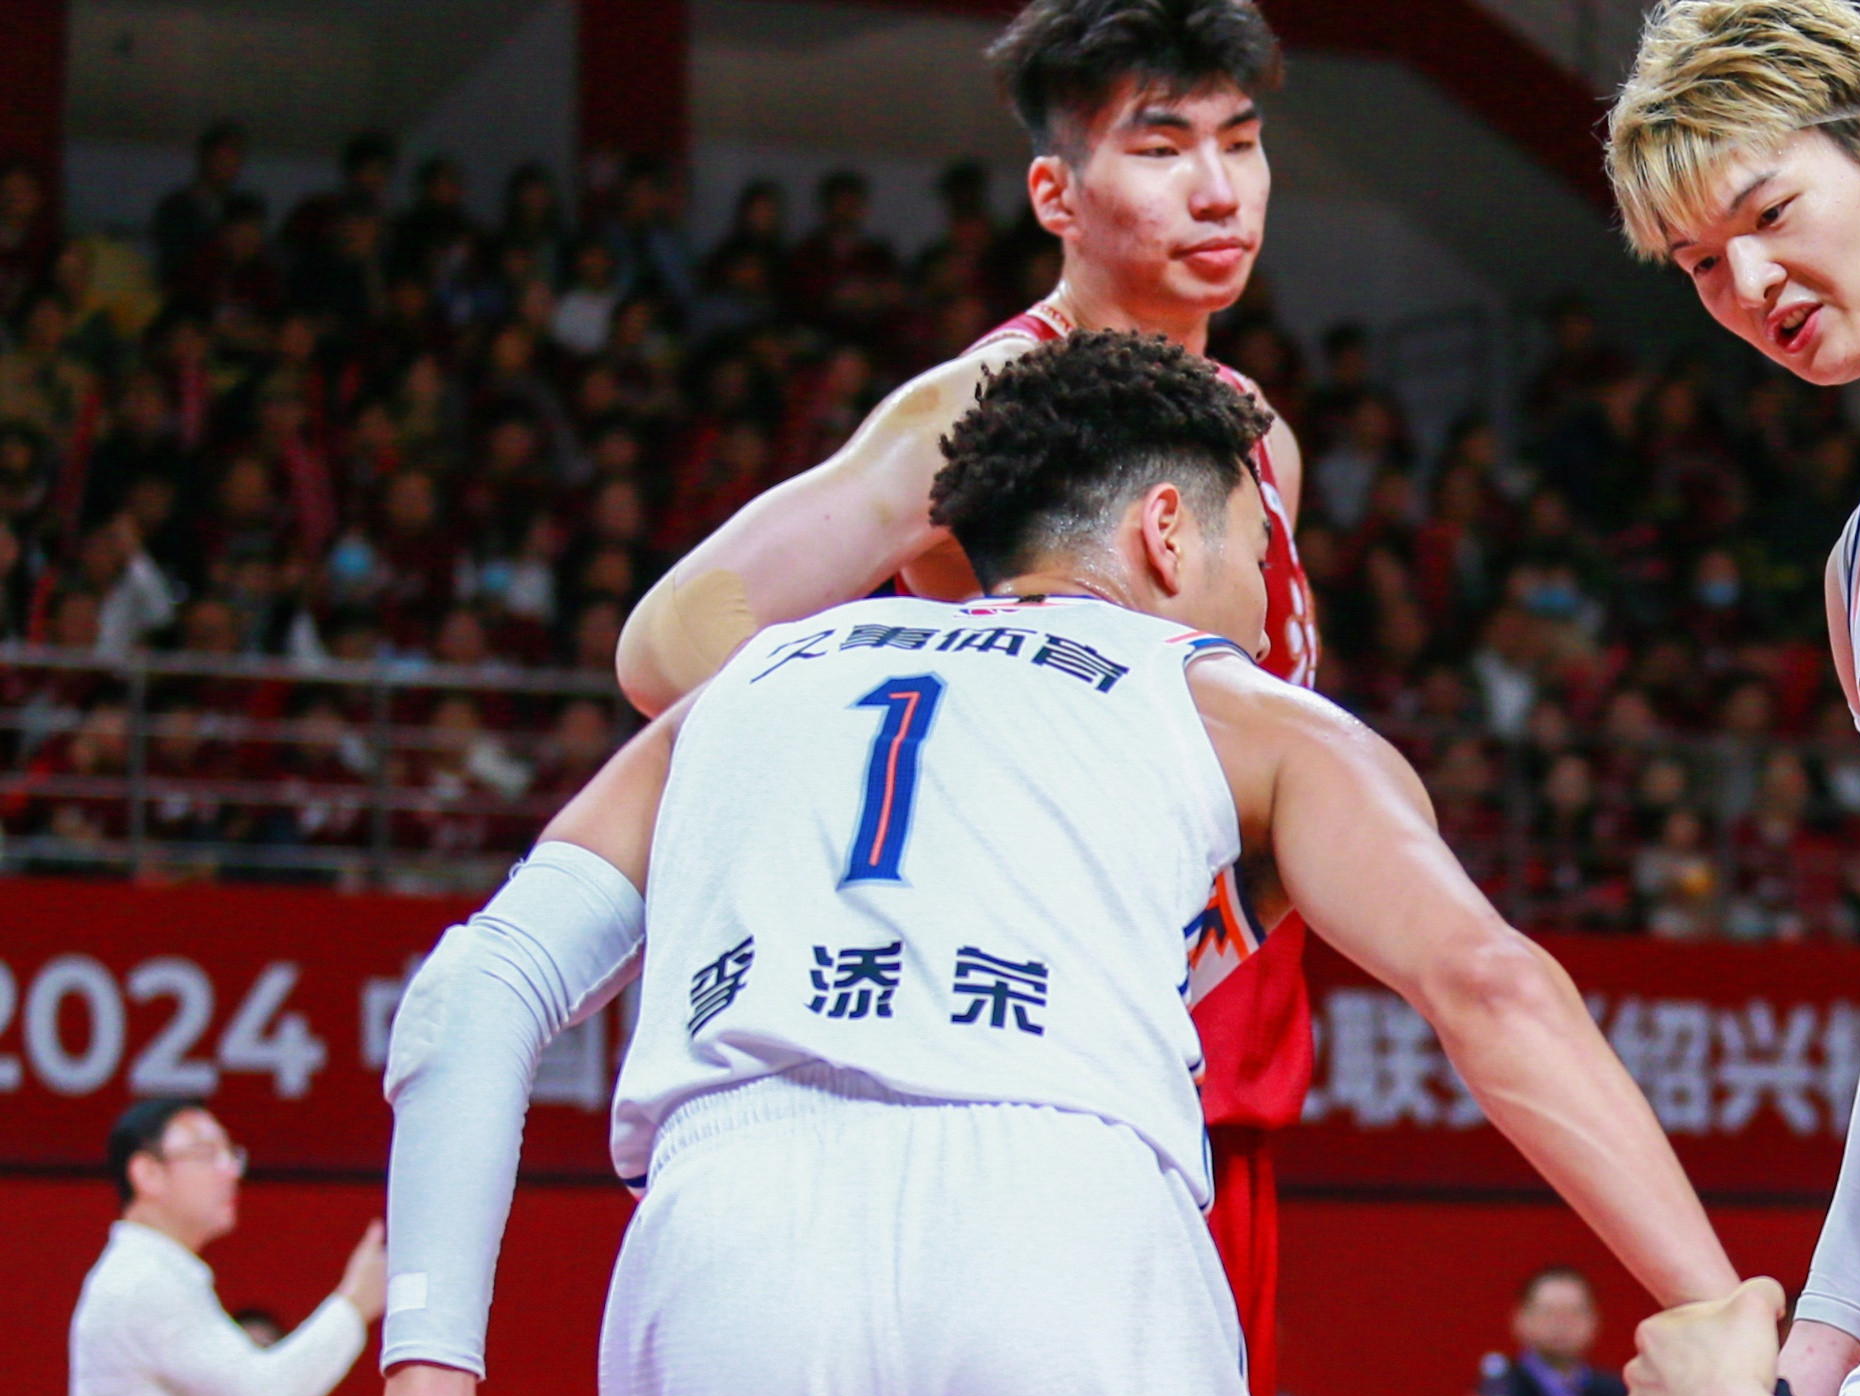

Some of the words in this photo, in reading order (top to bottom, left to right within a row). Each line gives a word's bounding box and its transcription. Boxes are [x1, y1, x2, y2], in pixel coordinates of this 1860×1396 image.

[749, 622, 1131, 694] 久事体育
[838, 671, 948, 892] 1
[0, 954, 327, 1098] 024
